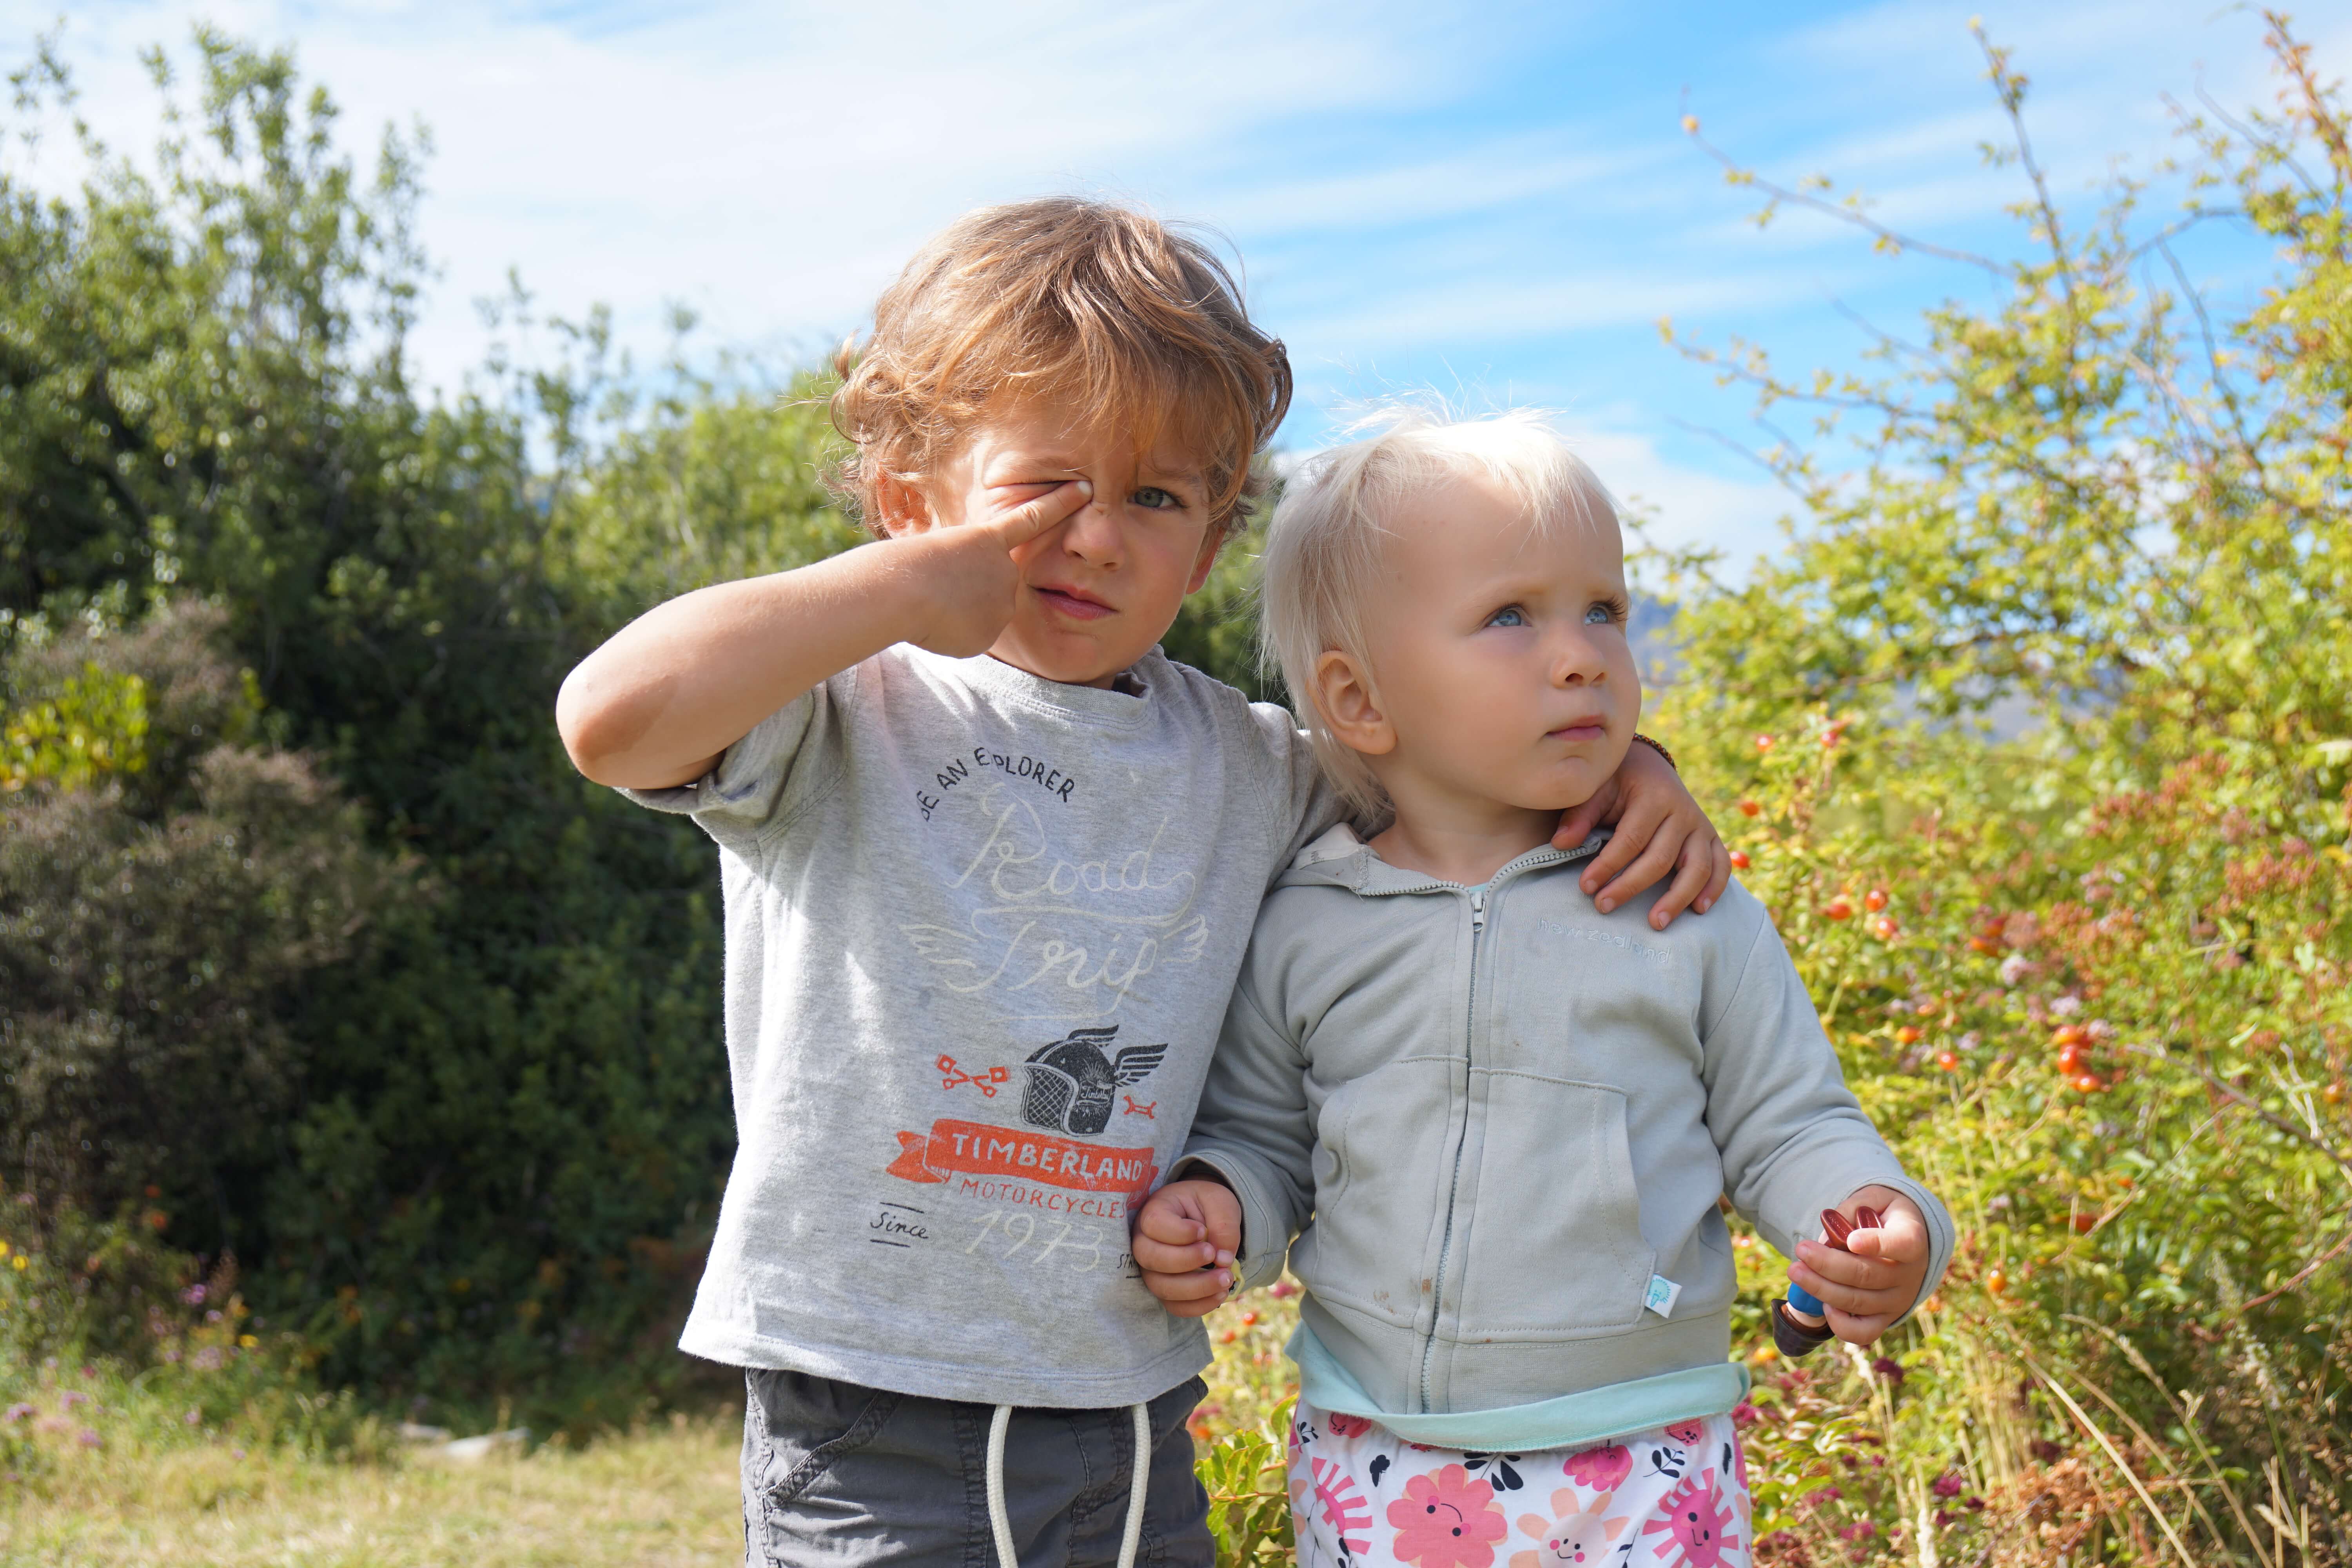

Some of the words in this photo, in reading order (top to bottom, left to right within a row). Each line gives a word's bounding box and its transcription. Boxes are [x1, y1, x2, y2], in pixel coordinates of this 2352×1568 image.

[937, 759, 969, 790] AN
[974, 746, 1075, 803] EPLORER
[945, 782, 1170, 900] Road
[1536, 916, 1581, 938] new
[1587, 929, 1671, 964] zealand
[944, 919, 1159, 1022] Trip
[952, 1132, 1143, 1181] TIMBERLAND
[959, 1178, 1126, 1218] MOTORCYCLES
[870, 1211, 929, 1239] Since
[965, 1209, 1103, 1272] 1973
